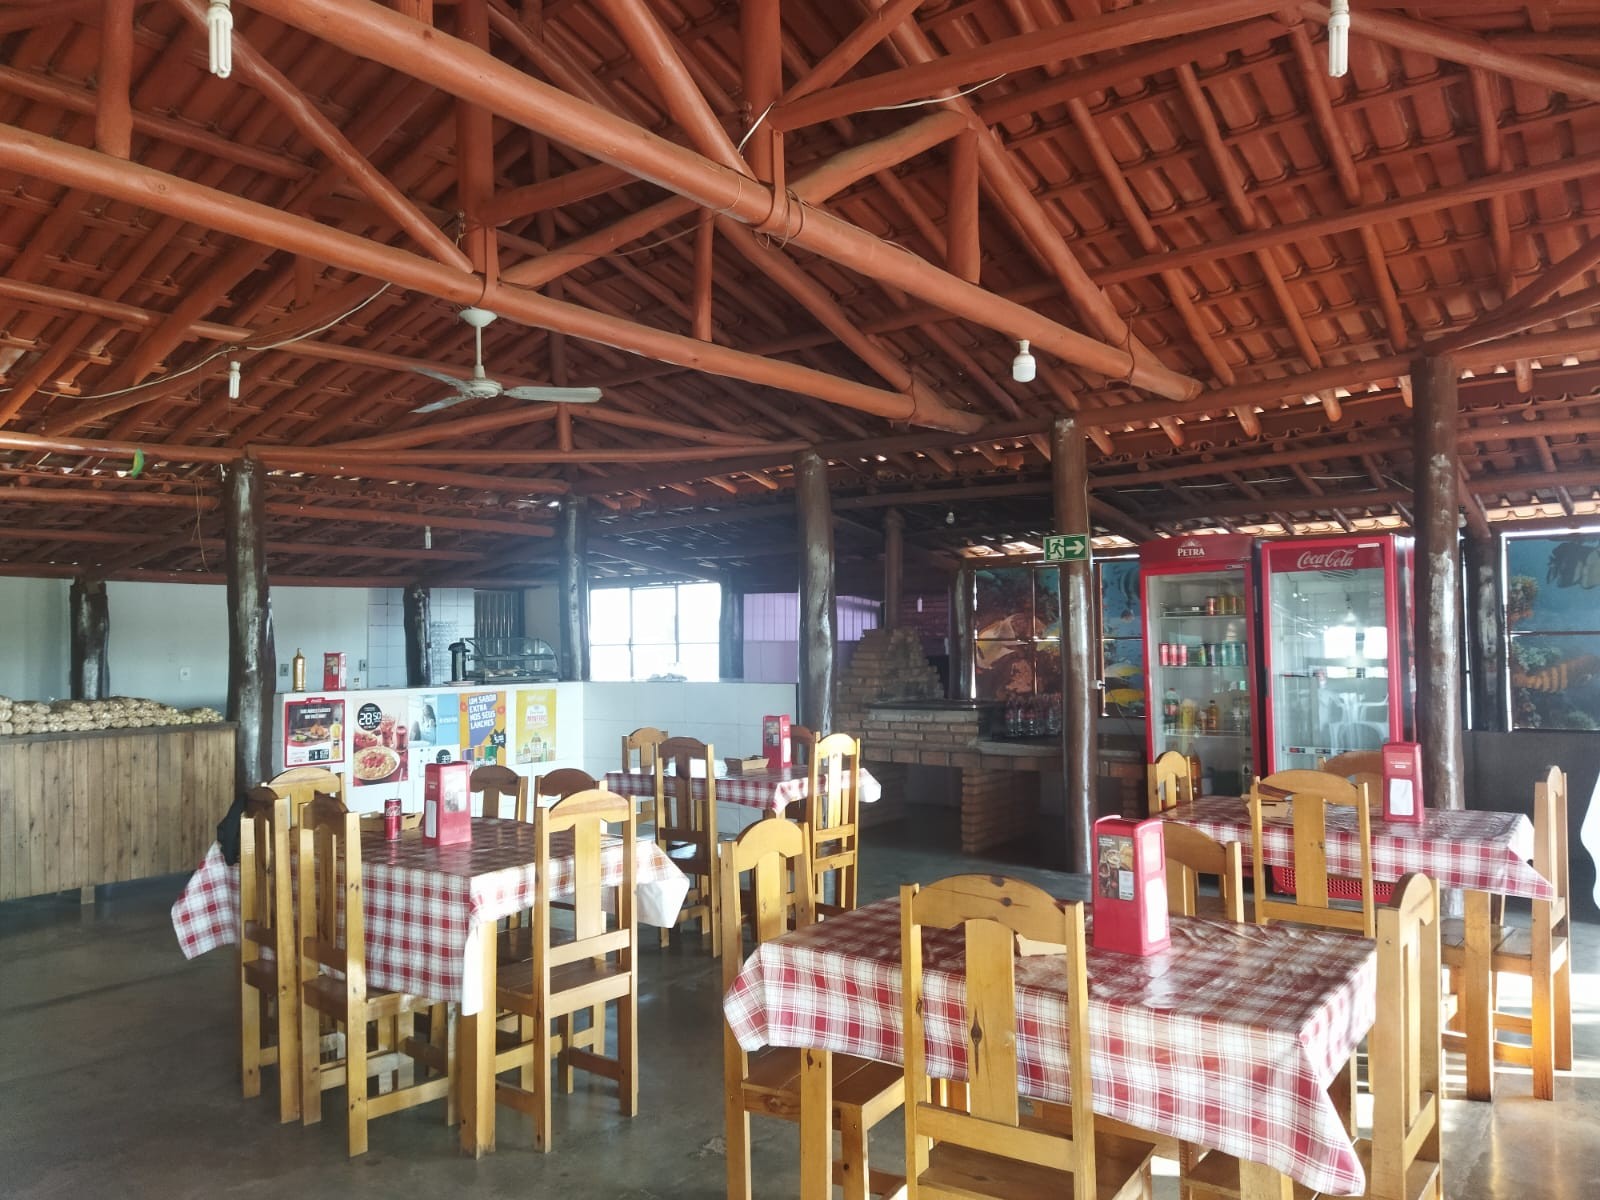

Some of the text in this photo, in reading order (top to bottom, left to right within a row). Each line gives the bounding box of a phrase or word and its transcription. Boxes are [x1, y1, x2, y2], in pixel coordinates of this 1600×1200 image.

[1177, 548, 1205, 557] PETRA
[469, 703, 487, 713] EXTRA
[469, 710, 496, 721] NOS SEUS
[470, 719, 495, 730] LANCHES
